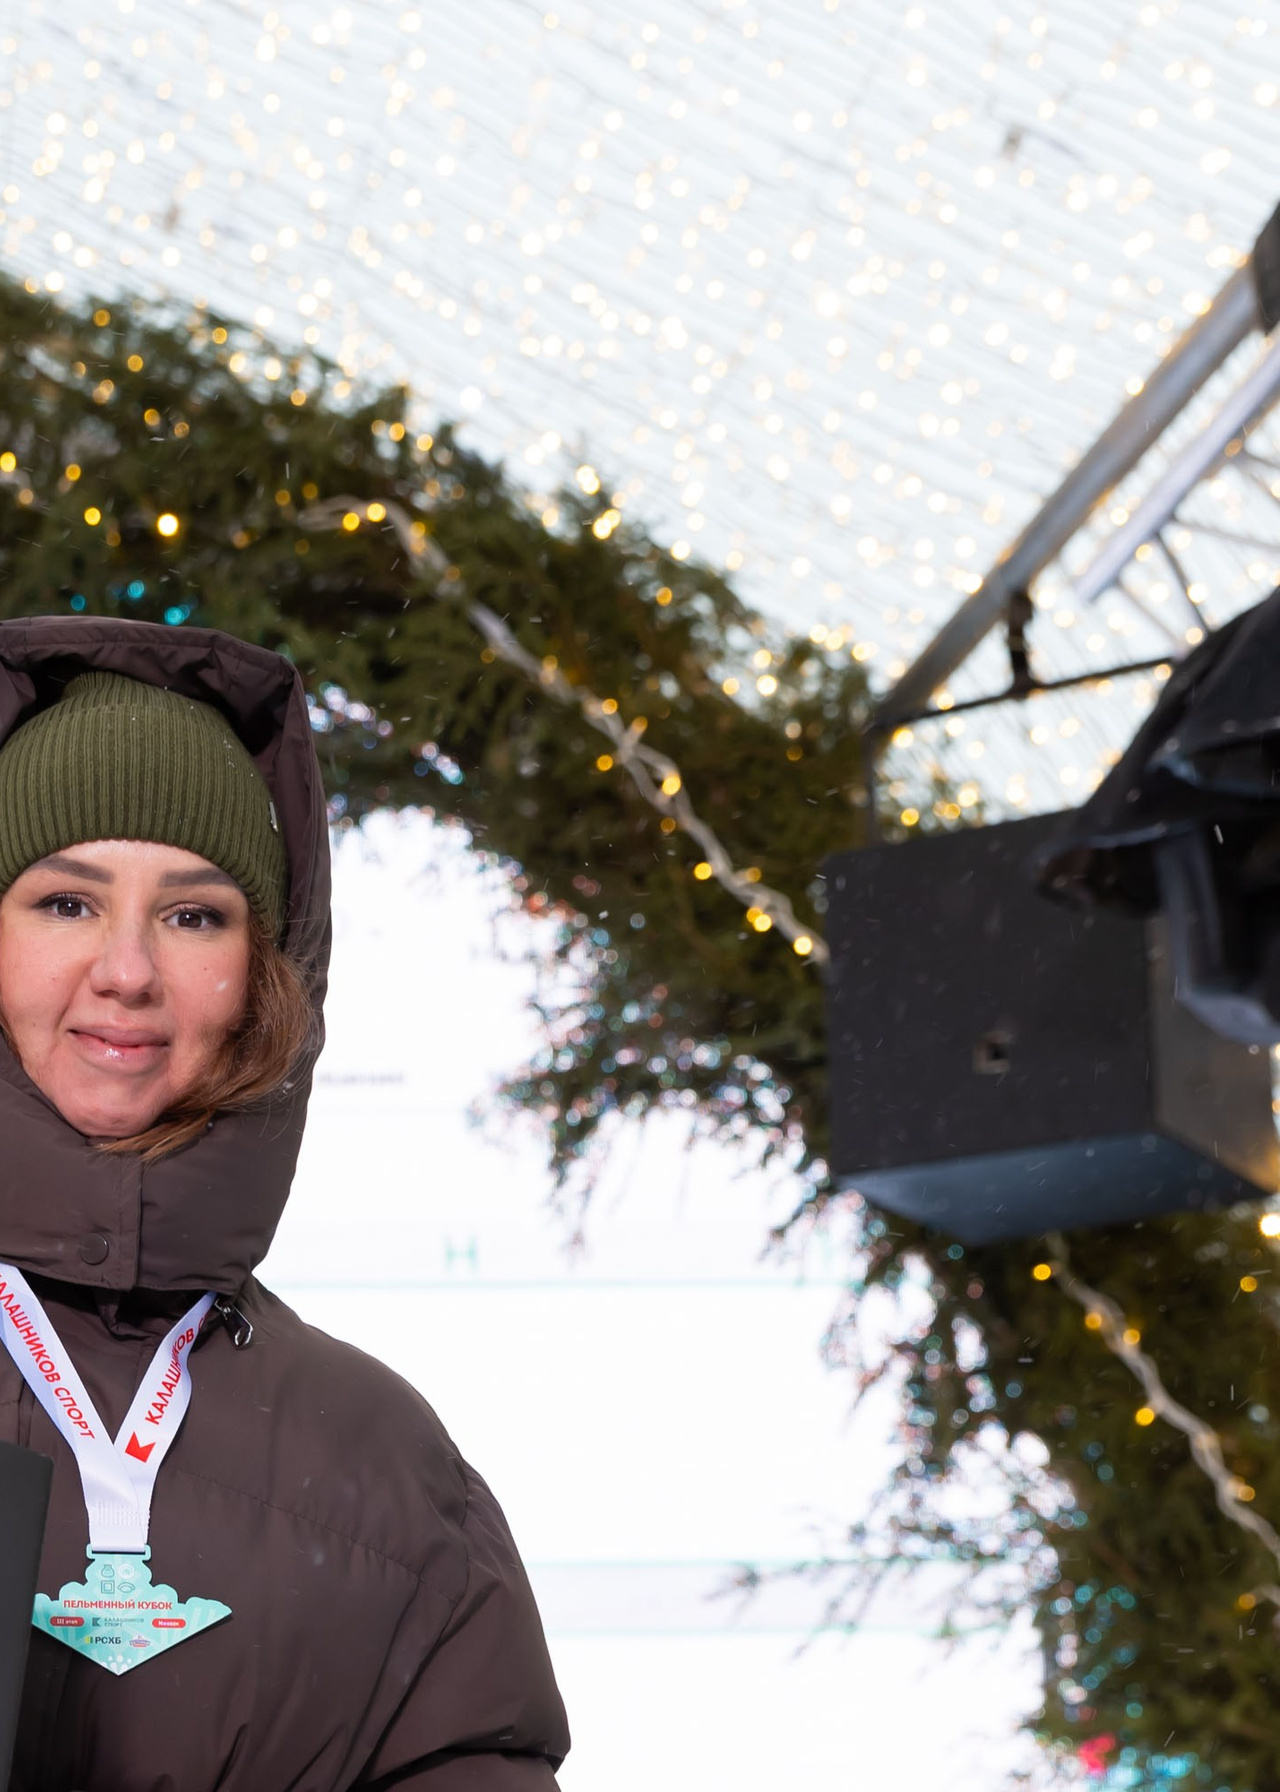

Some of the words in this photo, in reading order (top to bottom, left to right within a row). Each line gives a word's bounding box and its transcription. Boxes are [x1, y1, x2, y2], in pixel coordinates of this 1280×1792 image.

[54, 1386, 96, 1439] СПОРТ
[63, 1599, 135, 1609] ПЕЛЬМЕННЫЙ
[137, 1601, 172, 1610] КУБОК
[95, 1636, 121, 1644] РСХБ
